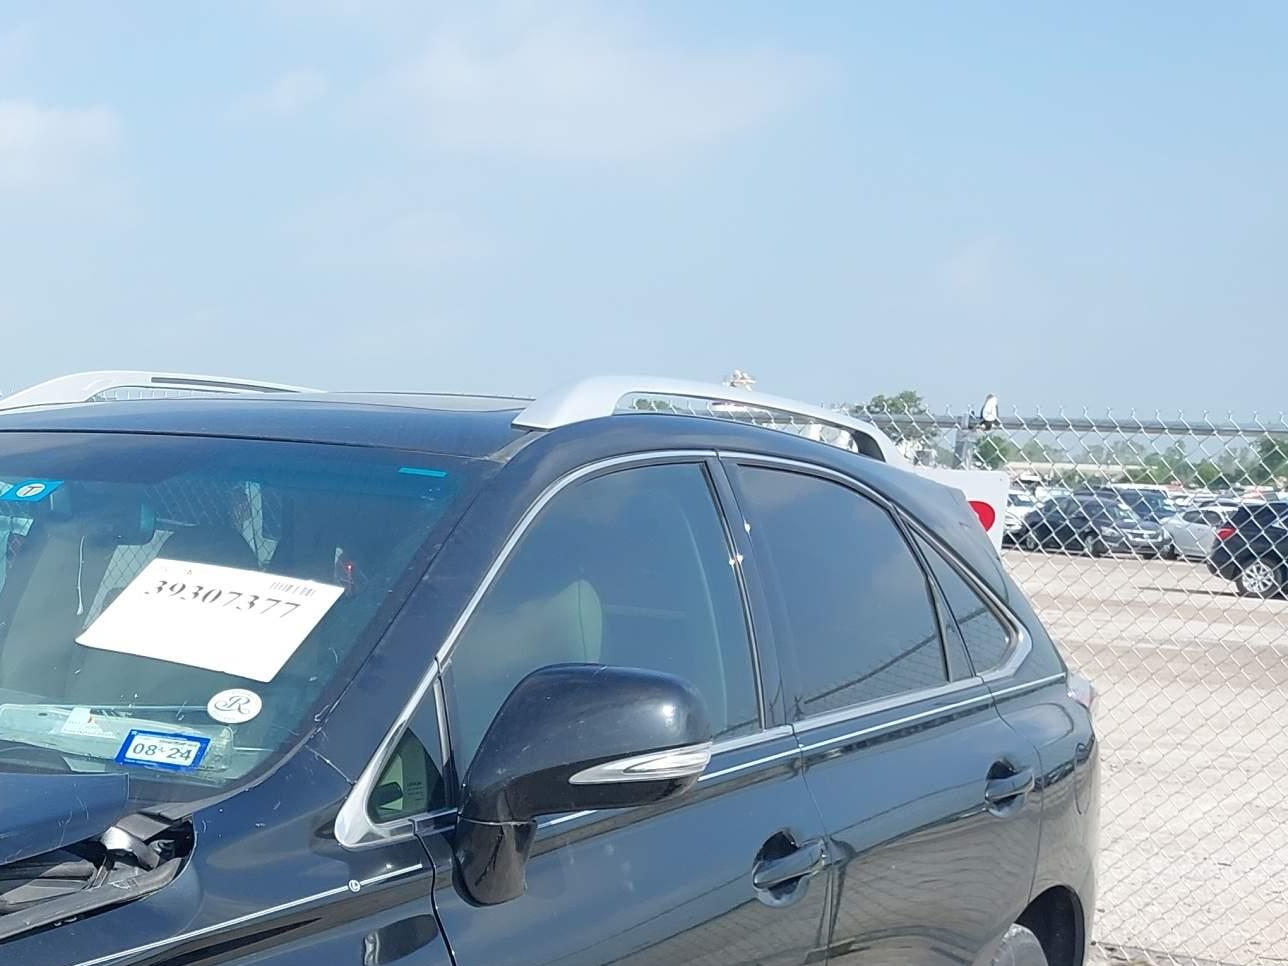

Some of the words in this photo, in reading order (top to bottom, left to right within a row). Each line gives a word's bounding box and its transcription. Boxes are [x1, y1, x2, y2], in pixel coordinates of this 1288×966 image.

[143, 579, 303, 618] 39307377
[132, 742, 158, 756] 08
[166, 747, 193, 761] 24
